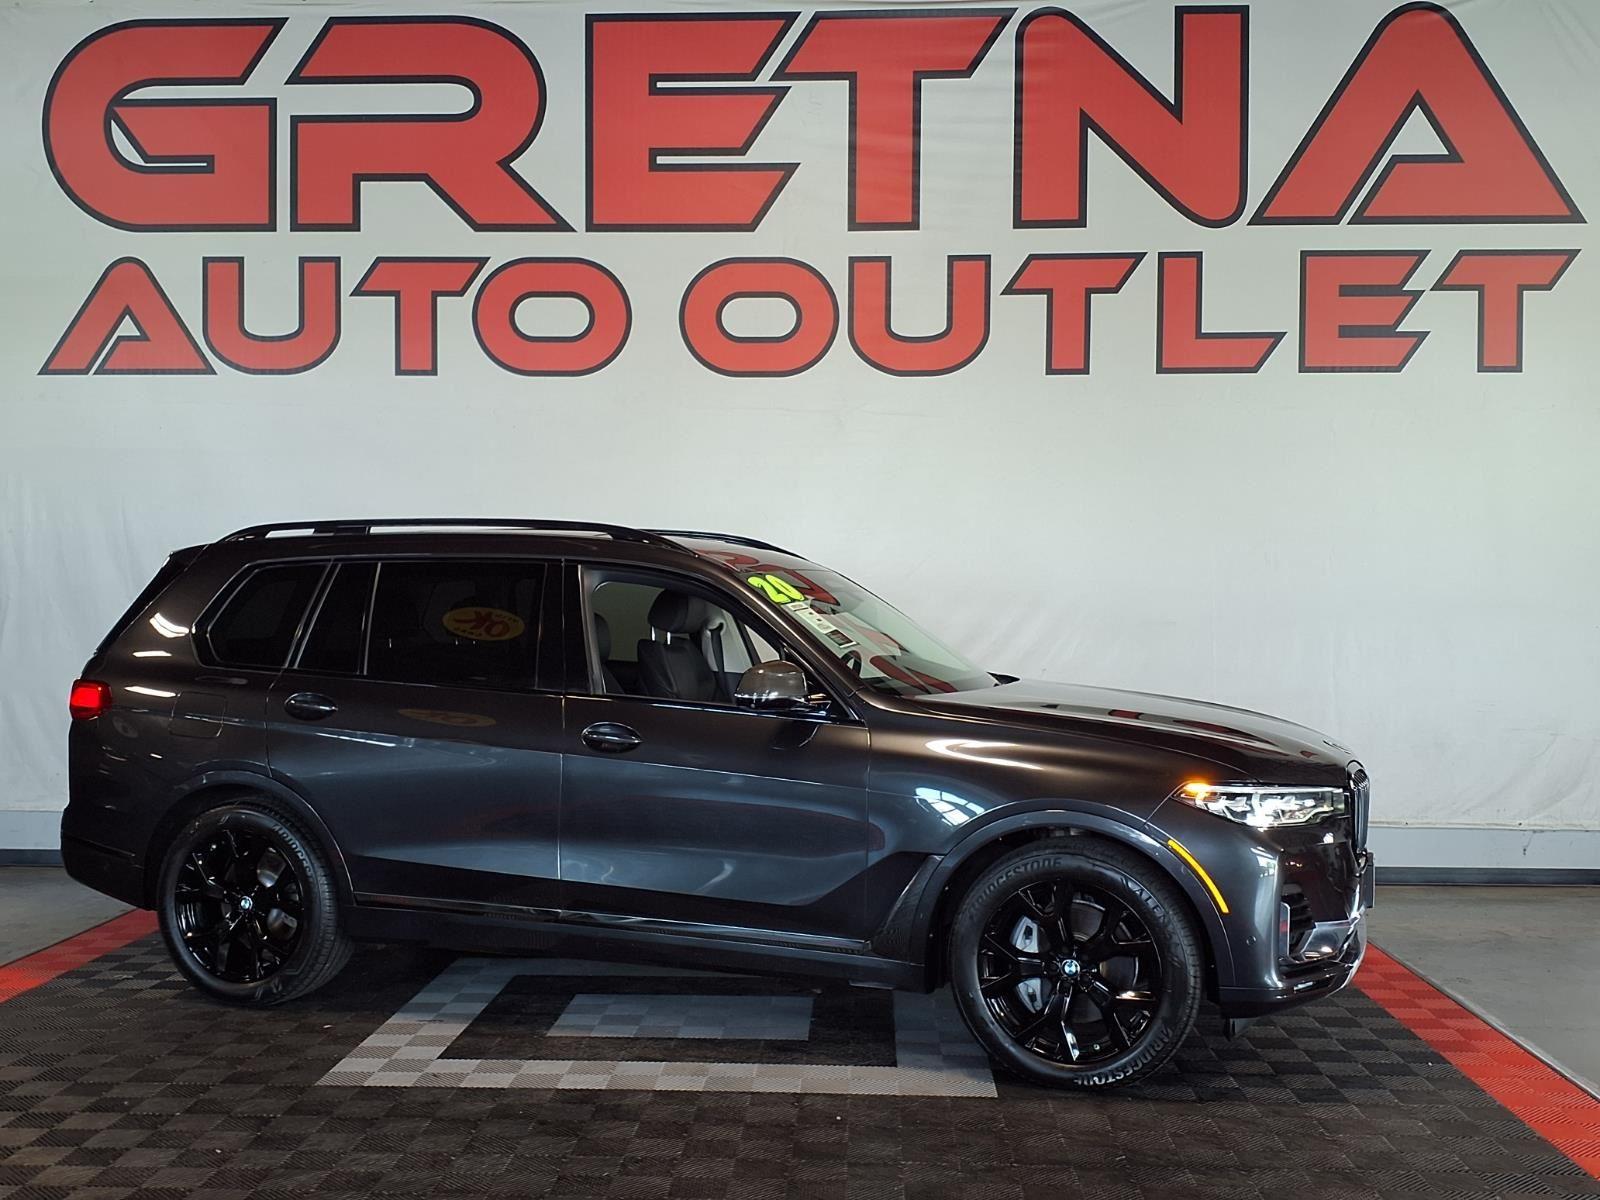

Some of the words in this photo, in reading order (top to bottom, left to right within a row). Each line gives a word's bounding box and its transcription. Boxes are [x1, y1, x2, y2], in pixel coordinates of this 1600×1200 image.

[42, 1, 1588, 232] GRETNA
[37, 255, 633, 377] AUTO
[679, 248, 1582, 378] OUTLET
[747, 574, 805, 605] 20
